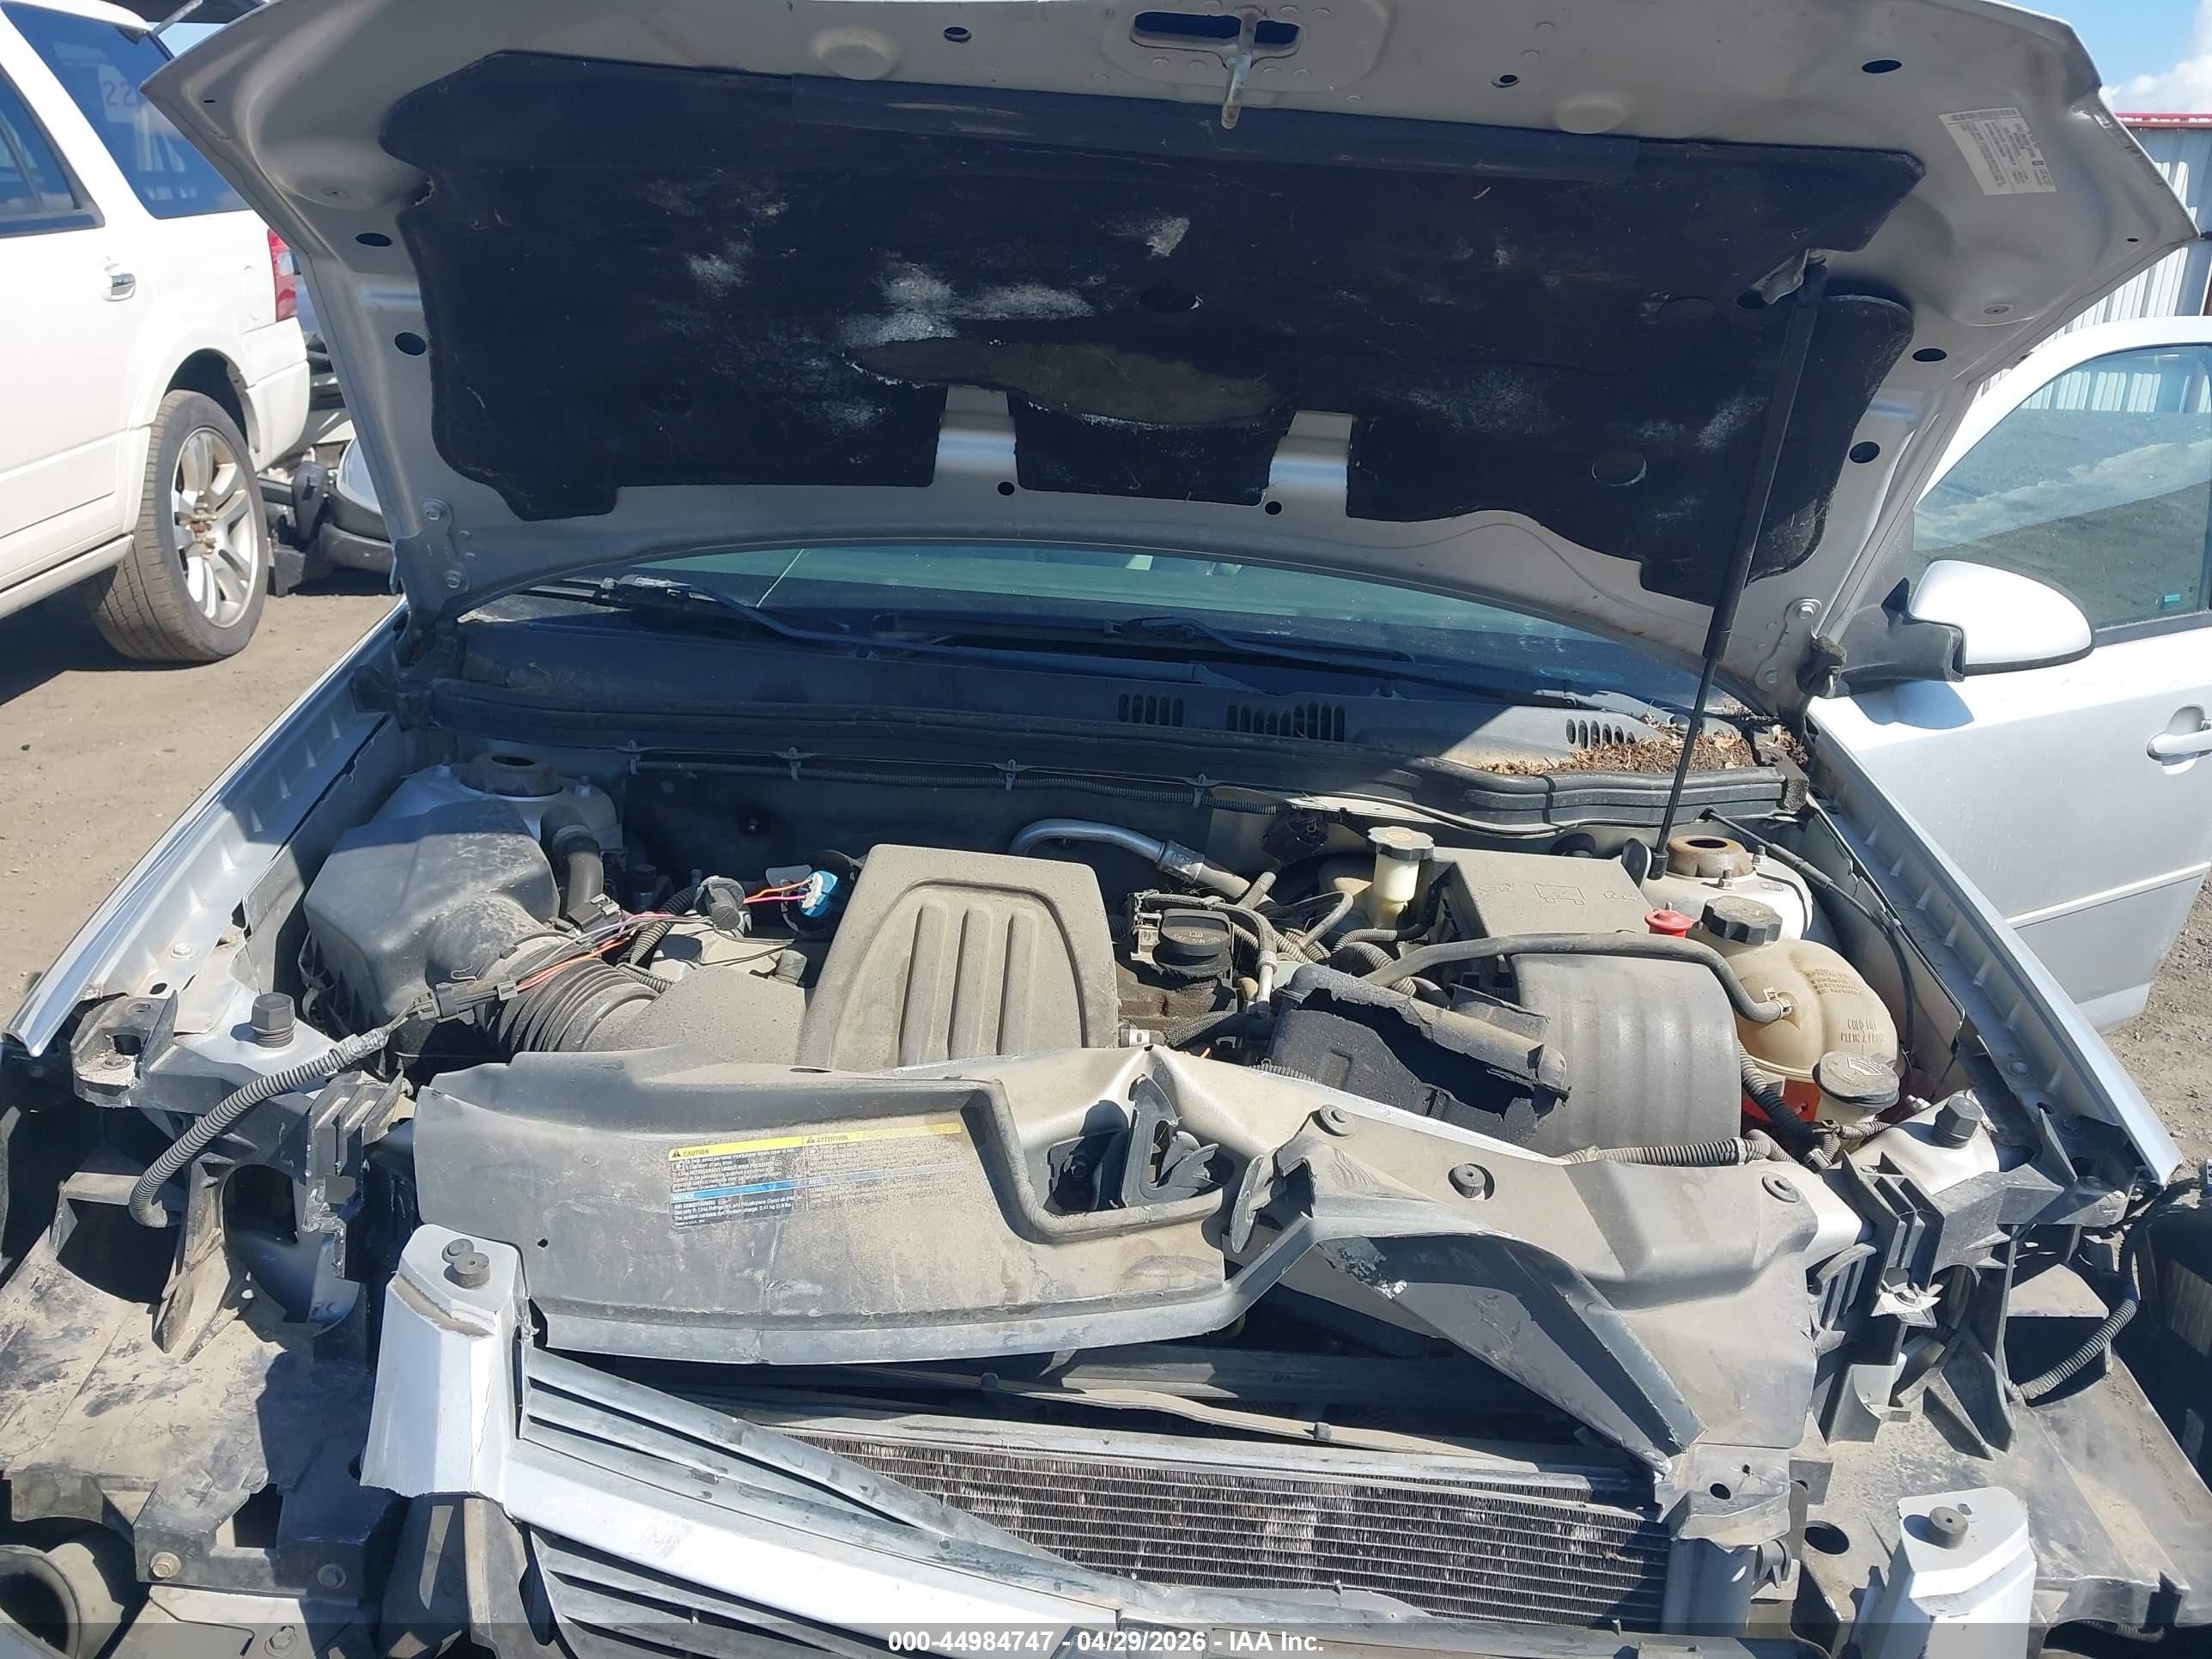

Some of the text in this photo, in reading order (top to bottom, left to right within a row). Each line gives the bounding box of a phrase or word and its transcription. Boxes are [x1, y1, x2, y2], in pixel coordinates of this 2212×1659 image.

[1171, 933, 1188, 942] SAE
[1847, 1018, 1864, 1030] COLD
[817, 1134, 848, 1143] ATTENTION
